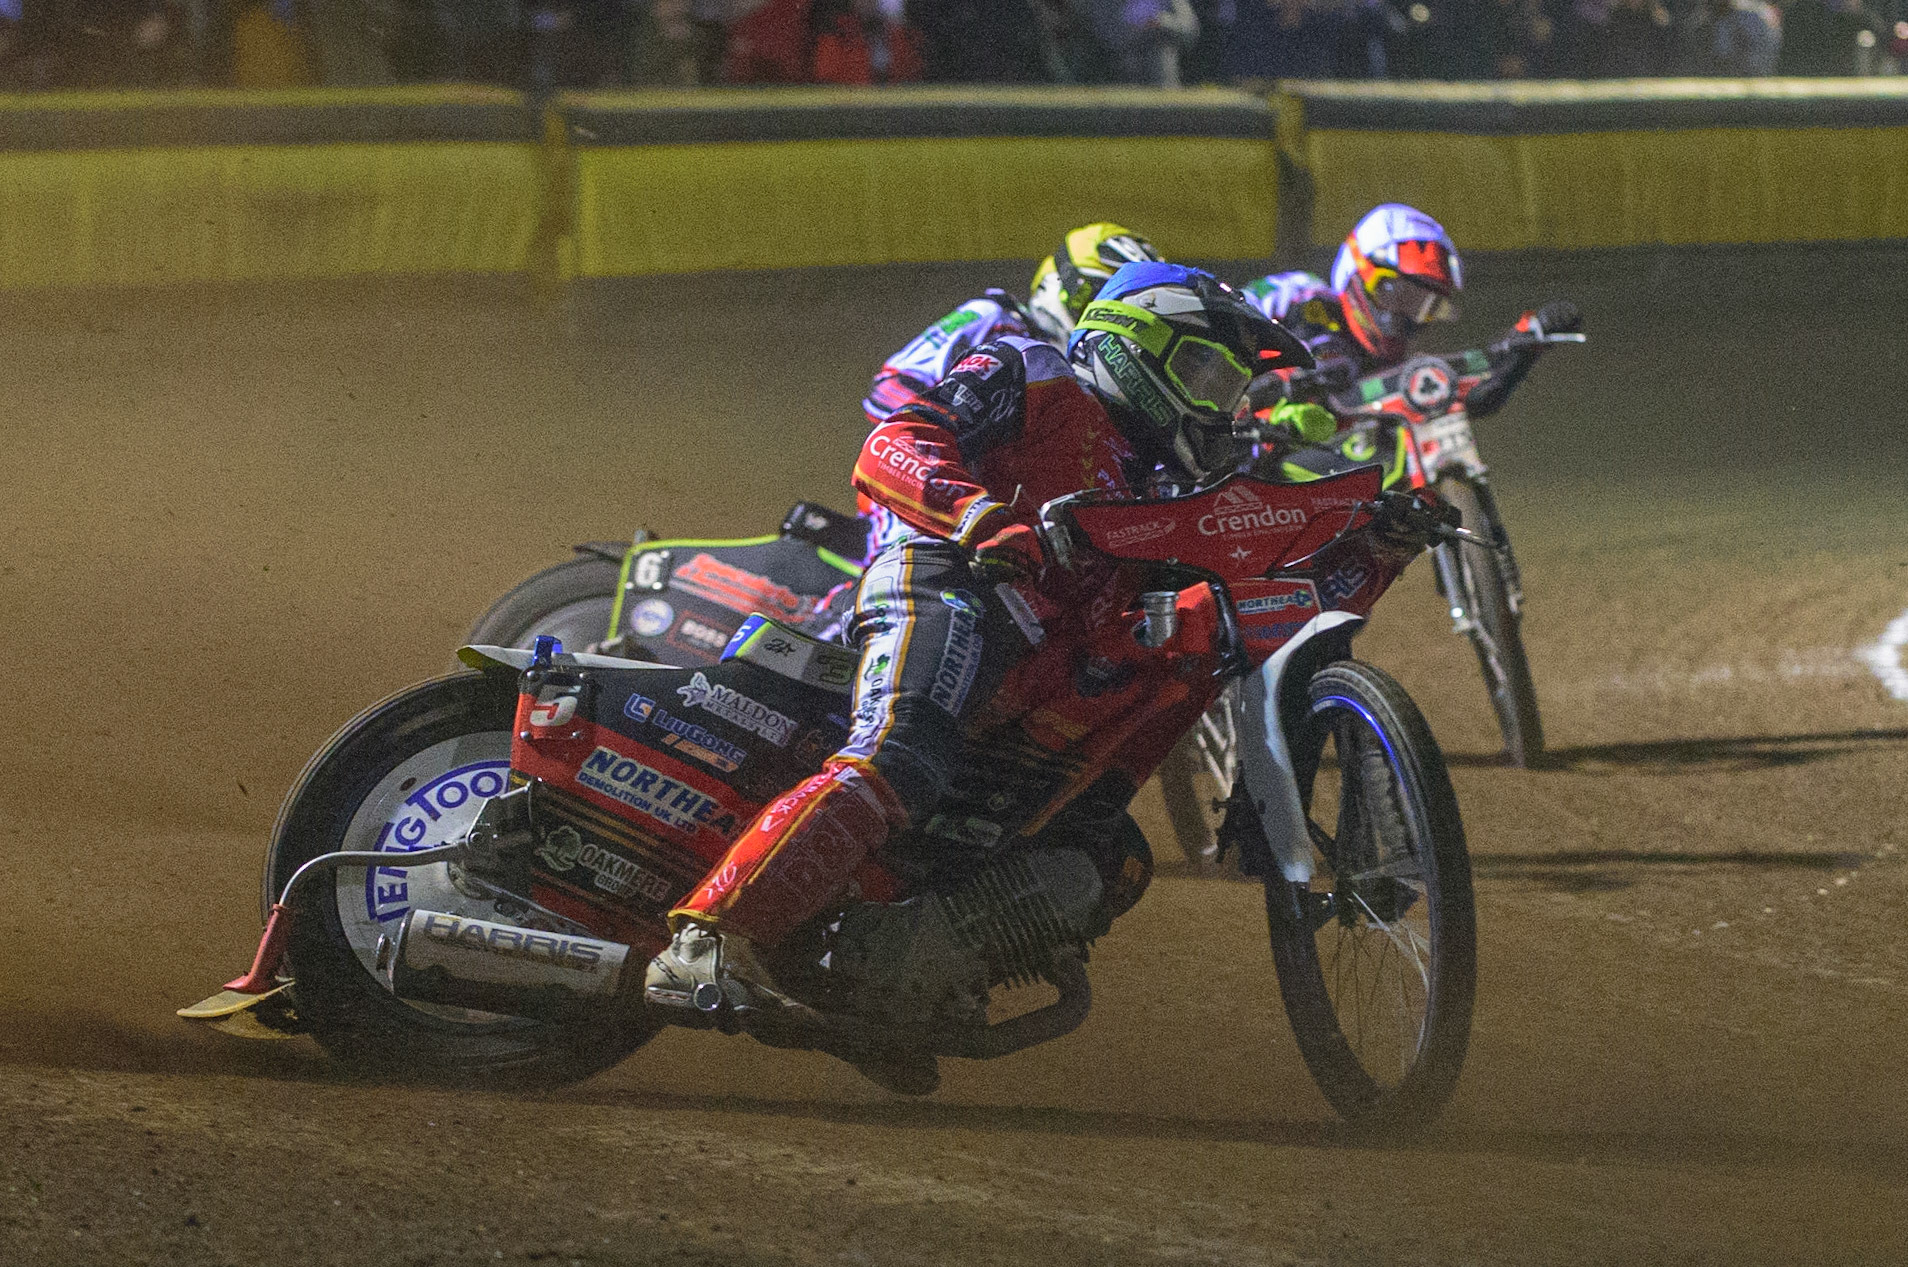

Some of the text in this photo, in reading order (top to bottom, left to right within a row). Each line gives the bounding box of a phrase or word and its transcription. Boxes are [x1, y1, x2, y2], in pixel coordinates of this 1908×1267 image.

[1198, 507, 1307, 536] Crendon
[634, 552, 661, 589] 6
[530, 684, 581, 726] 5
[711, 685, 794, 735] MALDON
[577, 771, 651, 812] DEMOLITION
[653, 807, 672, 821] UK
[579, 844, 669, 901] OAKMERE
[423, 914, 603, 966] HARRIS
